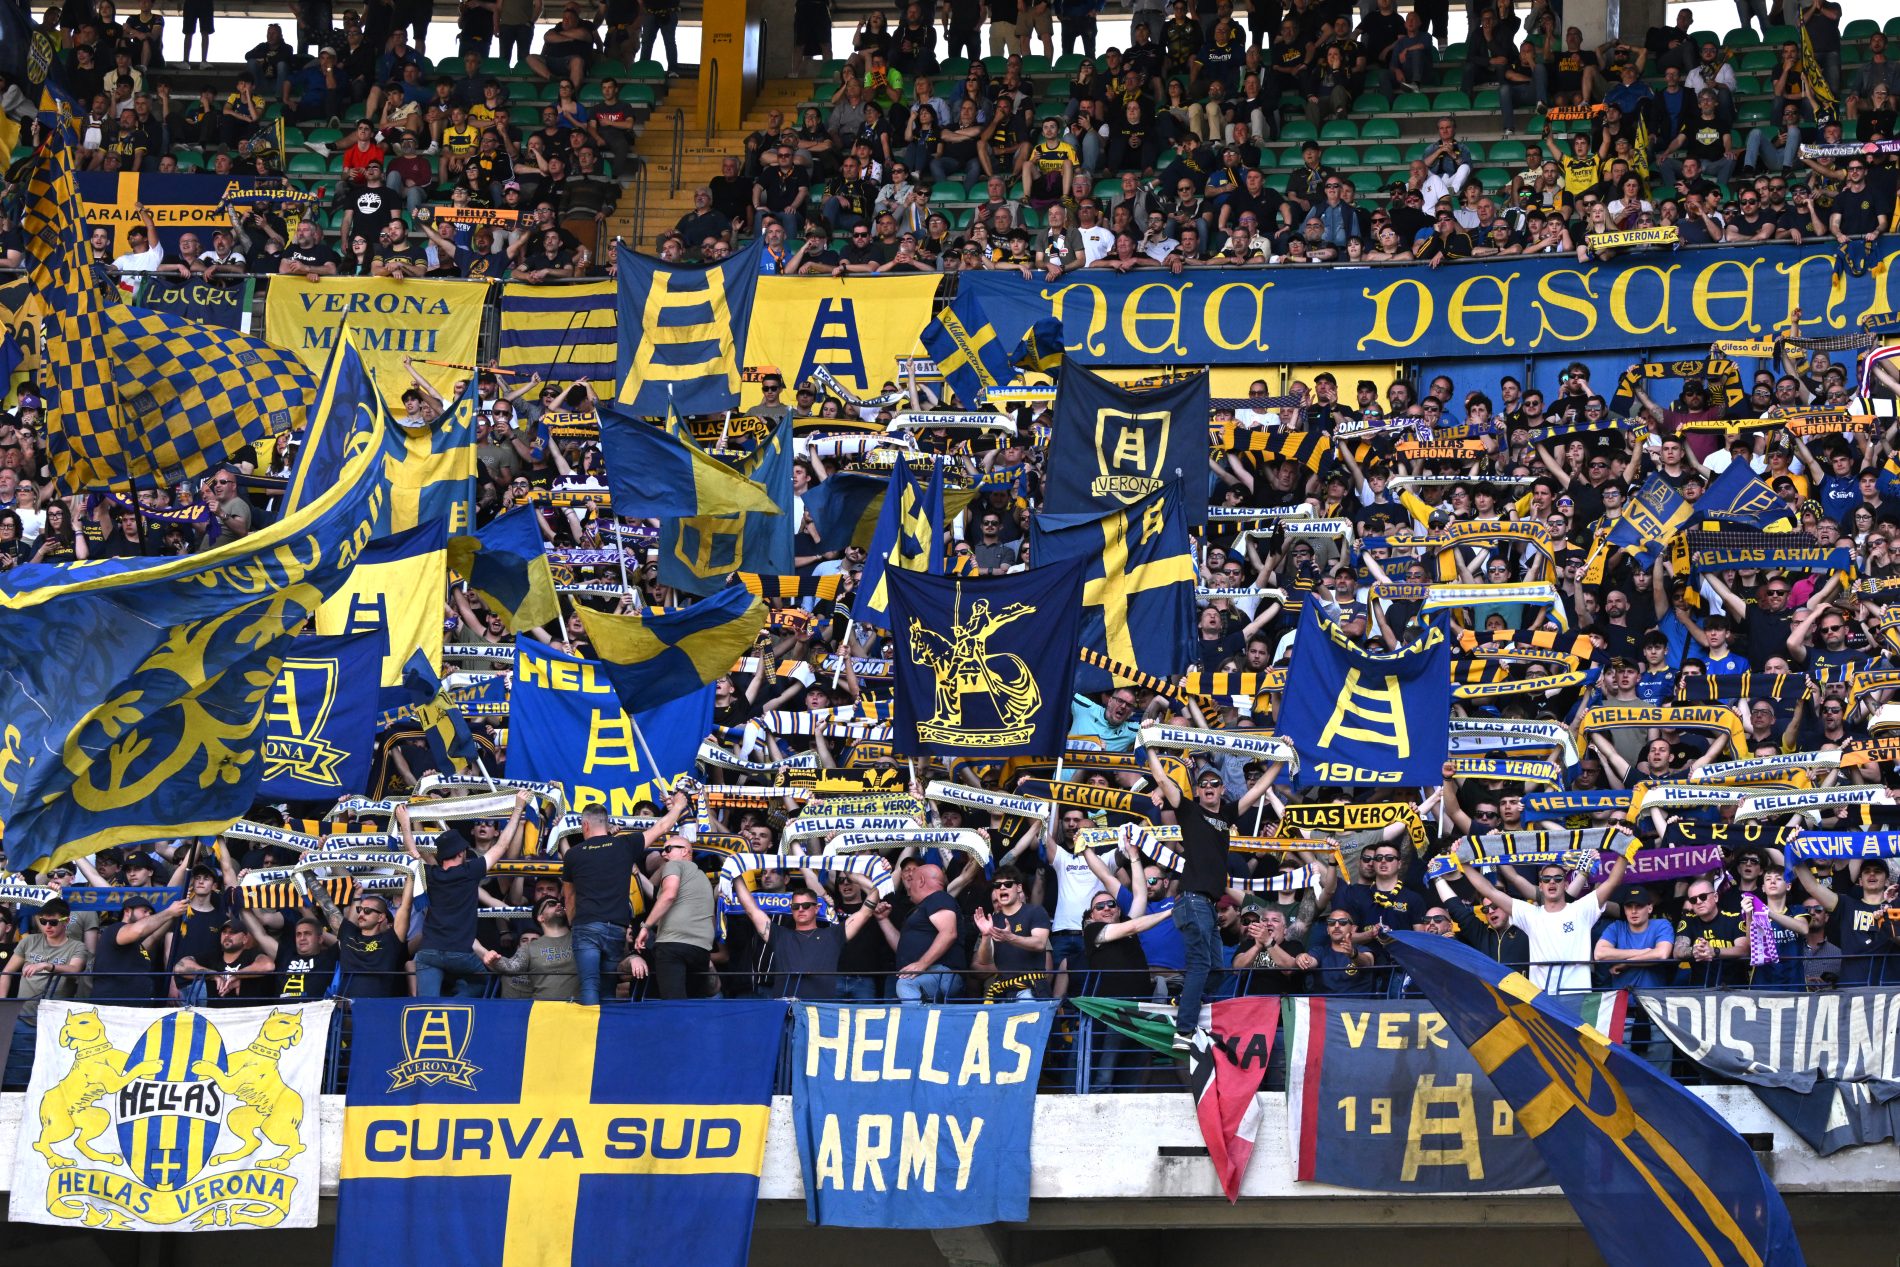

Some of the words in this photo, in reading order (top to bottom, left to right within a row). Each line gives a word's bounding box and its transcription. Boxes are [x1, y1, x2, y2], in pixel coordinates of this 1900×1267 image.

[456, 208, 497, 218] HELLAS
[1622, 231, 1660, 242] VERONA
[299, 292, 451, 316] VERONA
[302, 325, 439, 354] MCMIII
[909, 415, 956, 423] HELLAS
[960, 415, 996, 423] ARMY
[1418, 439, 1464, 449] HELLAS
[1405, 449, 1454, 459] VERONA
[1456, 449, 1477, 459] F.C.
[1098, 477, 1161, 493] VERONA
[538, 492, 603, 503] HELLAS
[1260, 505, 1298, 515] ARMY
[1303, 522, 1341, 532] ARMY
[1508, 522, 1552, 545] ARMY
[1773, 547, 1836, 561] ARMY
[1592, 706, 1664, 724] HELLAS
[1669, 708, 1725, 724] ARMY
[1510, 722, 1559, 736] ARMY
[1161, 730, 1226, 746] HELLAS
[1231, 739, 1280, 754] ARMY
[1313, 762, 1404, 783] 1903
[943, 787, 994, 805] HELLAS
[1000, 798, 1044, 813] ARMY
[1050, 783, 1133, 811] VERONA
[1530, 796, 1632, 812] HELLAS
[1754, 793, 1818, 811] HELLAS
[1825, 790, 1876, 803] ARMY
[837, 802, 877, 815] HELLAS
[1347, 804, 1415, 828] VERONA
[794, 818, 855, 833] HELLAS
[862, 818, 908, 829] ARMY
[326, 836, 386, 851] HELLAS
[843, 832, 905, 846] HELLAS
[912, 831, 960, 843] ARMY
[0, 886, 51, 901] ARMY
[805, 1006, 1040, 1086] HELLAS
[406, 1060, 459, 1075] VERONA
[119, 1080, 222, 1118] HELLAS
[365, 1117, 584, 1162] CURVA
[605, 1117, 742, 1160] SUD
[816, 1111, 985, 1192] ARMY
[58, 1172, 153, 1214] HELLAS
[175, 1173, 285, 1214] VERONA
